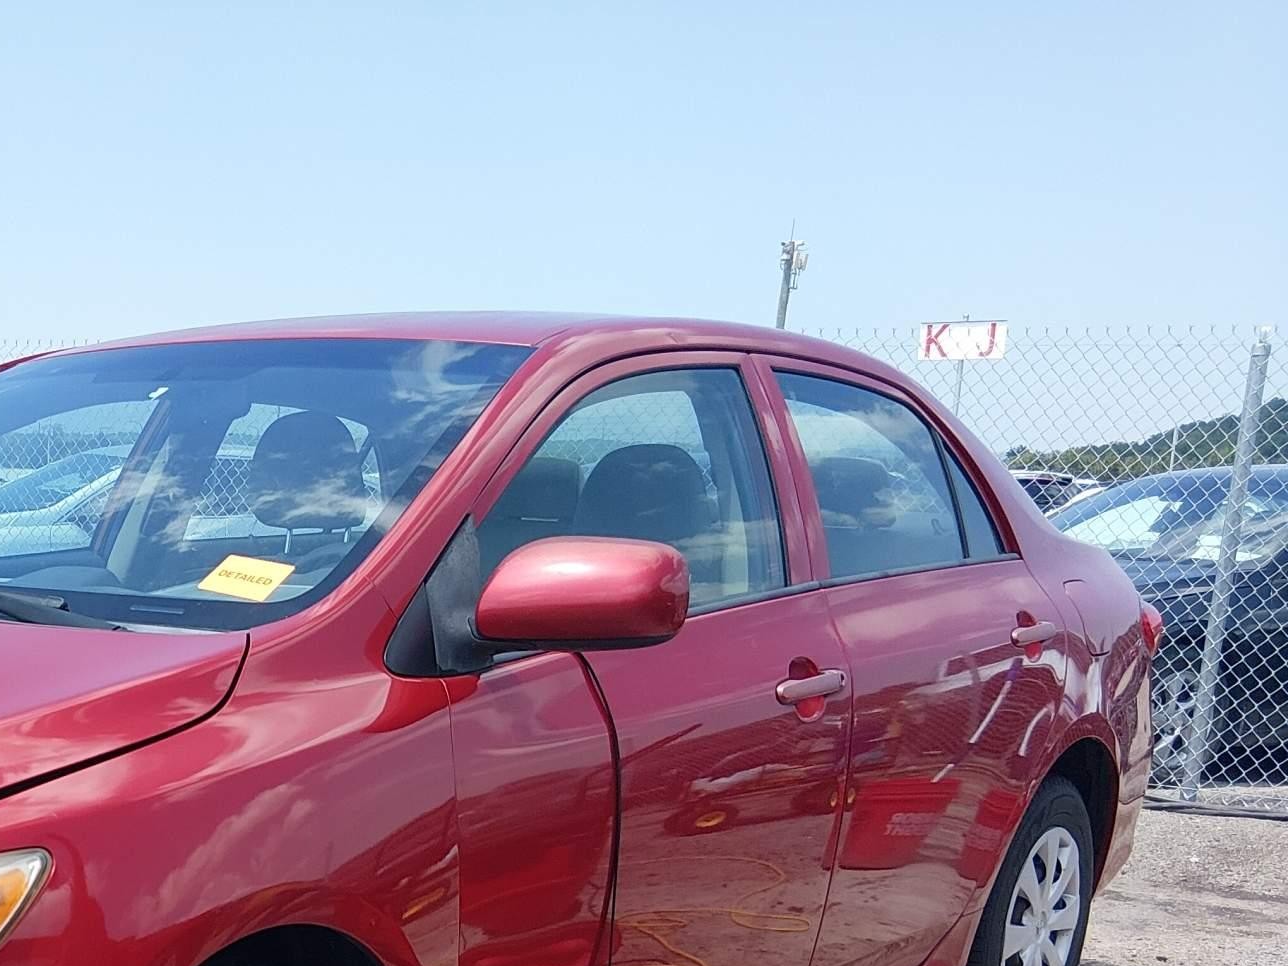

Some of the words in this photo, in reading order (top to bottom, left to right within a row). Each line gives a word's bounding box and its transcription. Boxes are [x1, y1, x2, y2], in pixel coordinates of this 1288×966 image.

[924, 324, 949, 358] K
[978, 322, 997, 357] J
[218, 569, 273, 586] DETAILED
